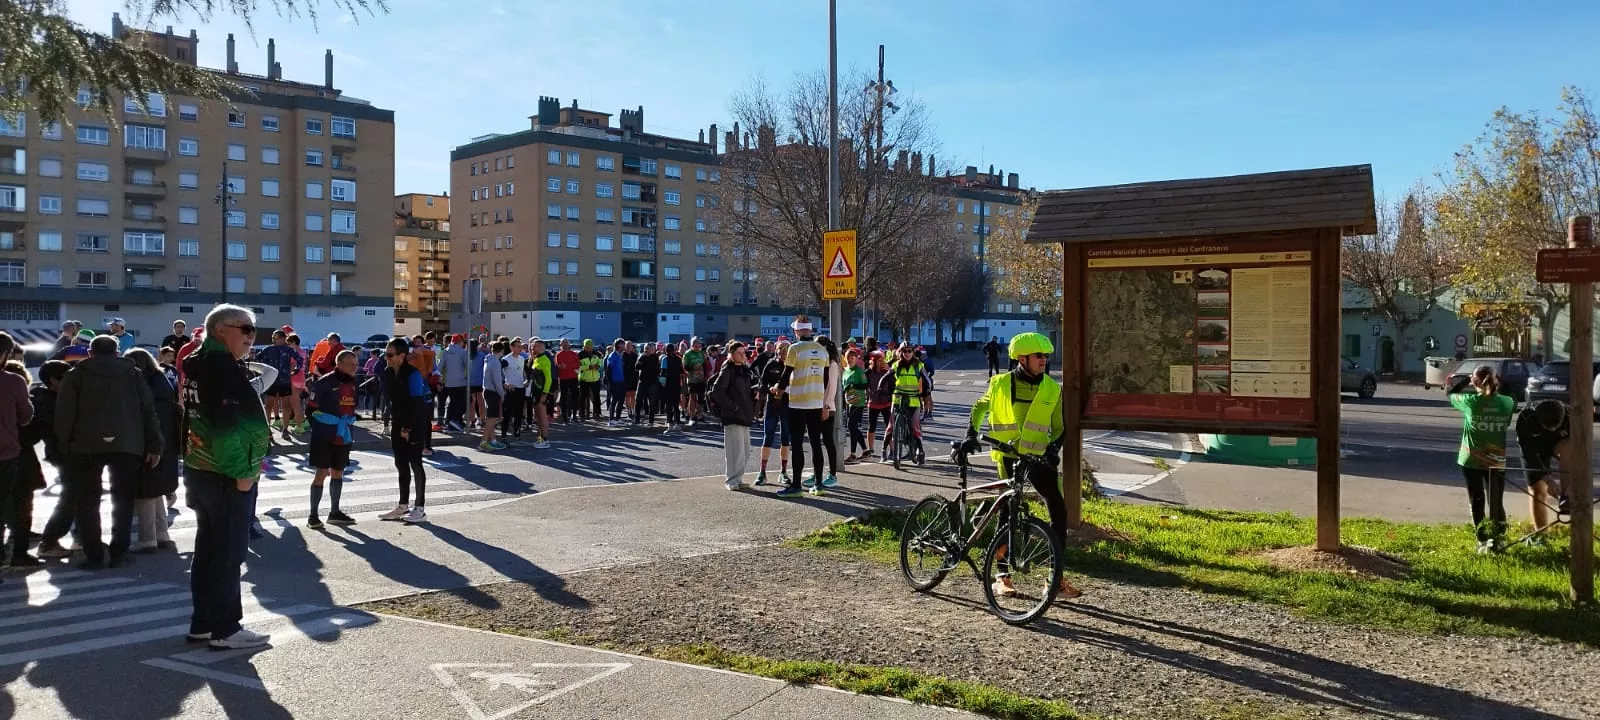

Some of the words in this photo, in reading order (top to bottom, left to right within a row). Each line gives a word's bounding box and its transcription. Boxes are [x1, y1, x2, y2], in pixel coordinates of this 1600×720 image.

[1088, 249, 1112, 257] Camino
[1113, 248, 1137, 256] Natural
[1190, 245, 1229, 253] Canfranero
